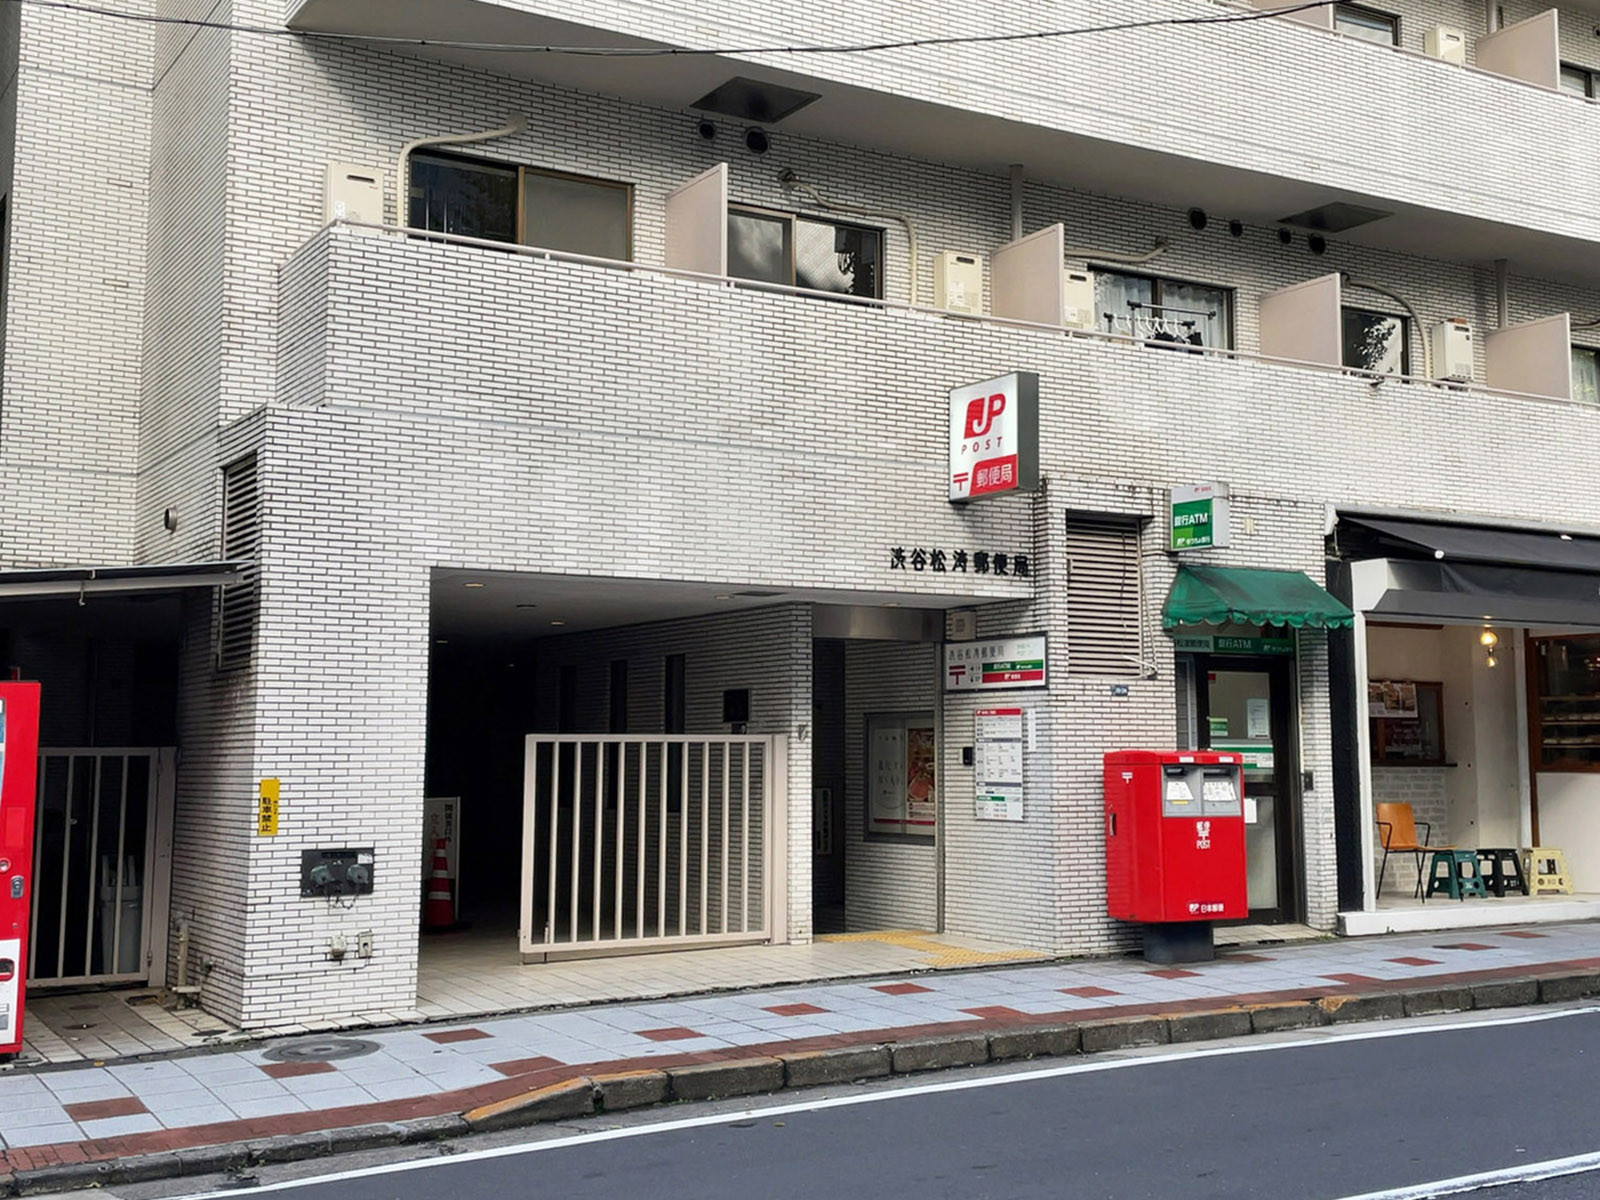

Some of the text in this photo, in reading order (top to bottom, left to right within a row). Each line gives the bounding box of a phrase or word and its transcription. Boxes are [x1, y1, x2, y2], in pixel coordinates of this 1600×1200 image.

[964, 393, 1006, 439] JP
[961, 436, 1003, 455] POST
[976, 465, 1013, 488] 郵便局
[1174, 512, 1208, 527] 銀行ATM
[261, 797, 272, 833] 駐車禁止
